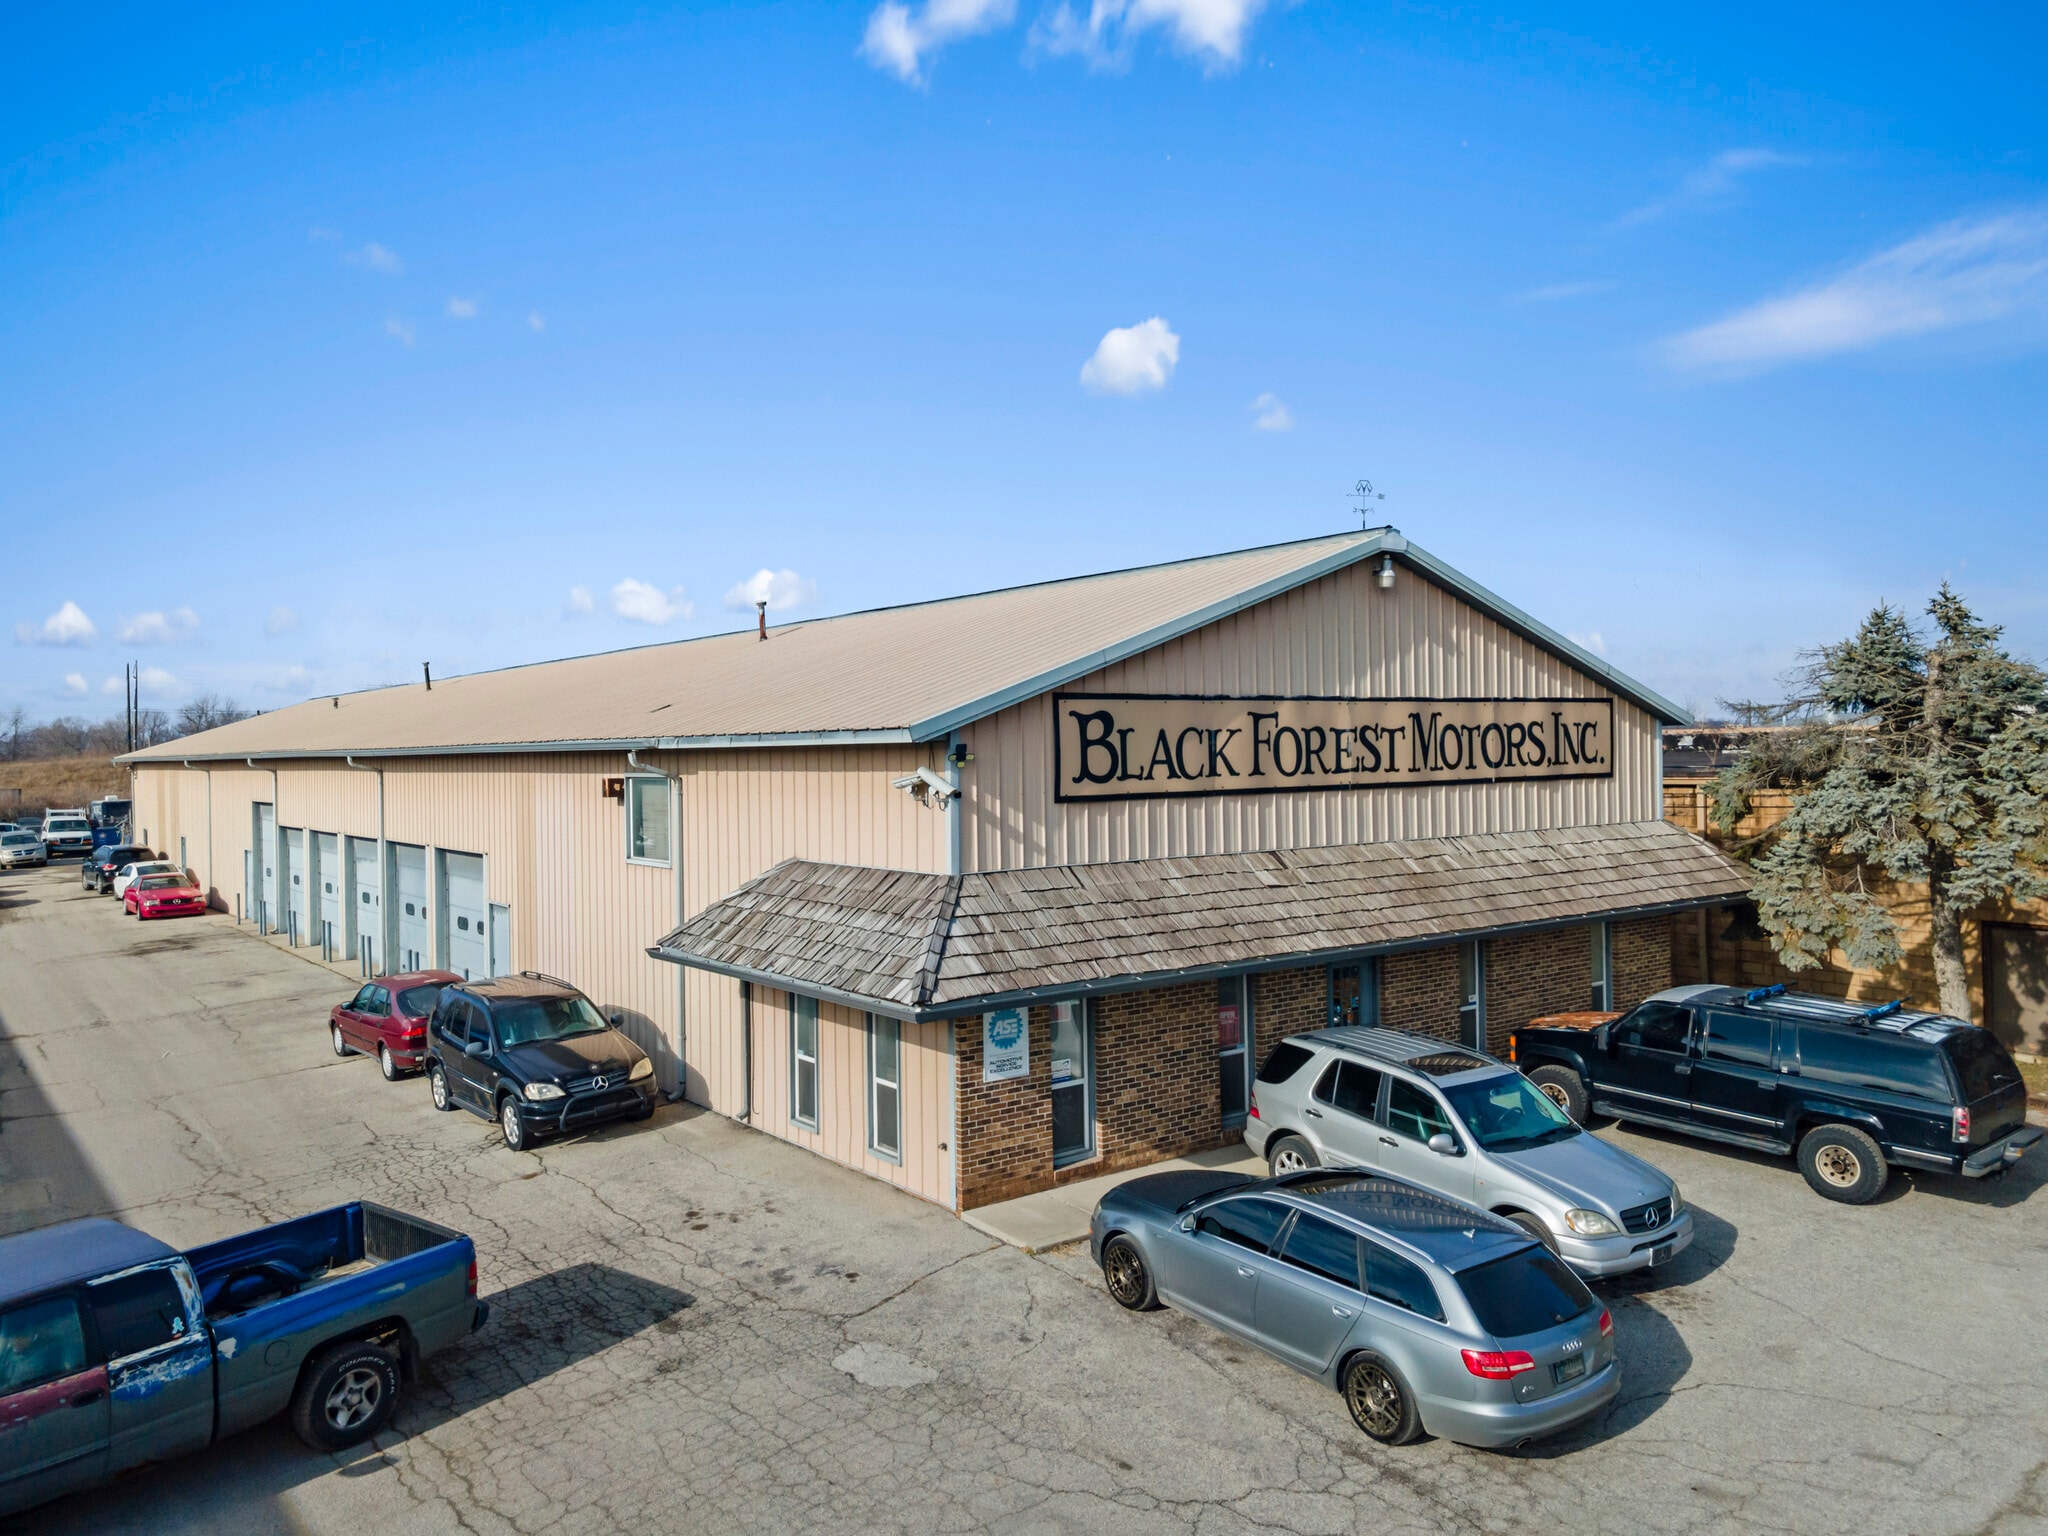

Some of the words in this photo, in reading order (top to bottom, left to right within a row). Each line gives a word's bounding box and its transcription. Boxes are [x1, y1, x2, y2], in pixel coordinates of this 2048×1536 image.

[1069, 710, 1243, 785] BLACK
[1247, 711, 1406, 777] FOREST
[993, 1018, 1017, 1036] ASE
[989, 1056, 1023, 1066] AUTOMOTIVE
[989, 1065, 1023, 1074] EXCELLENCE
